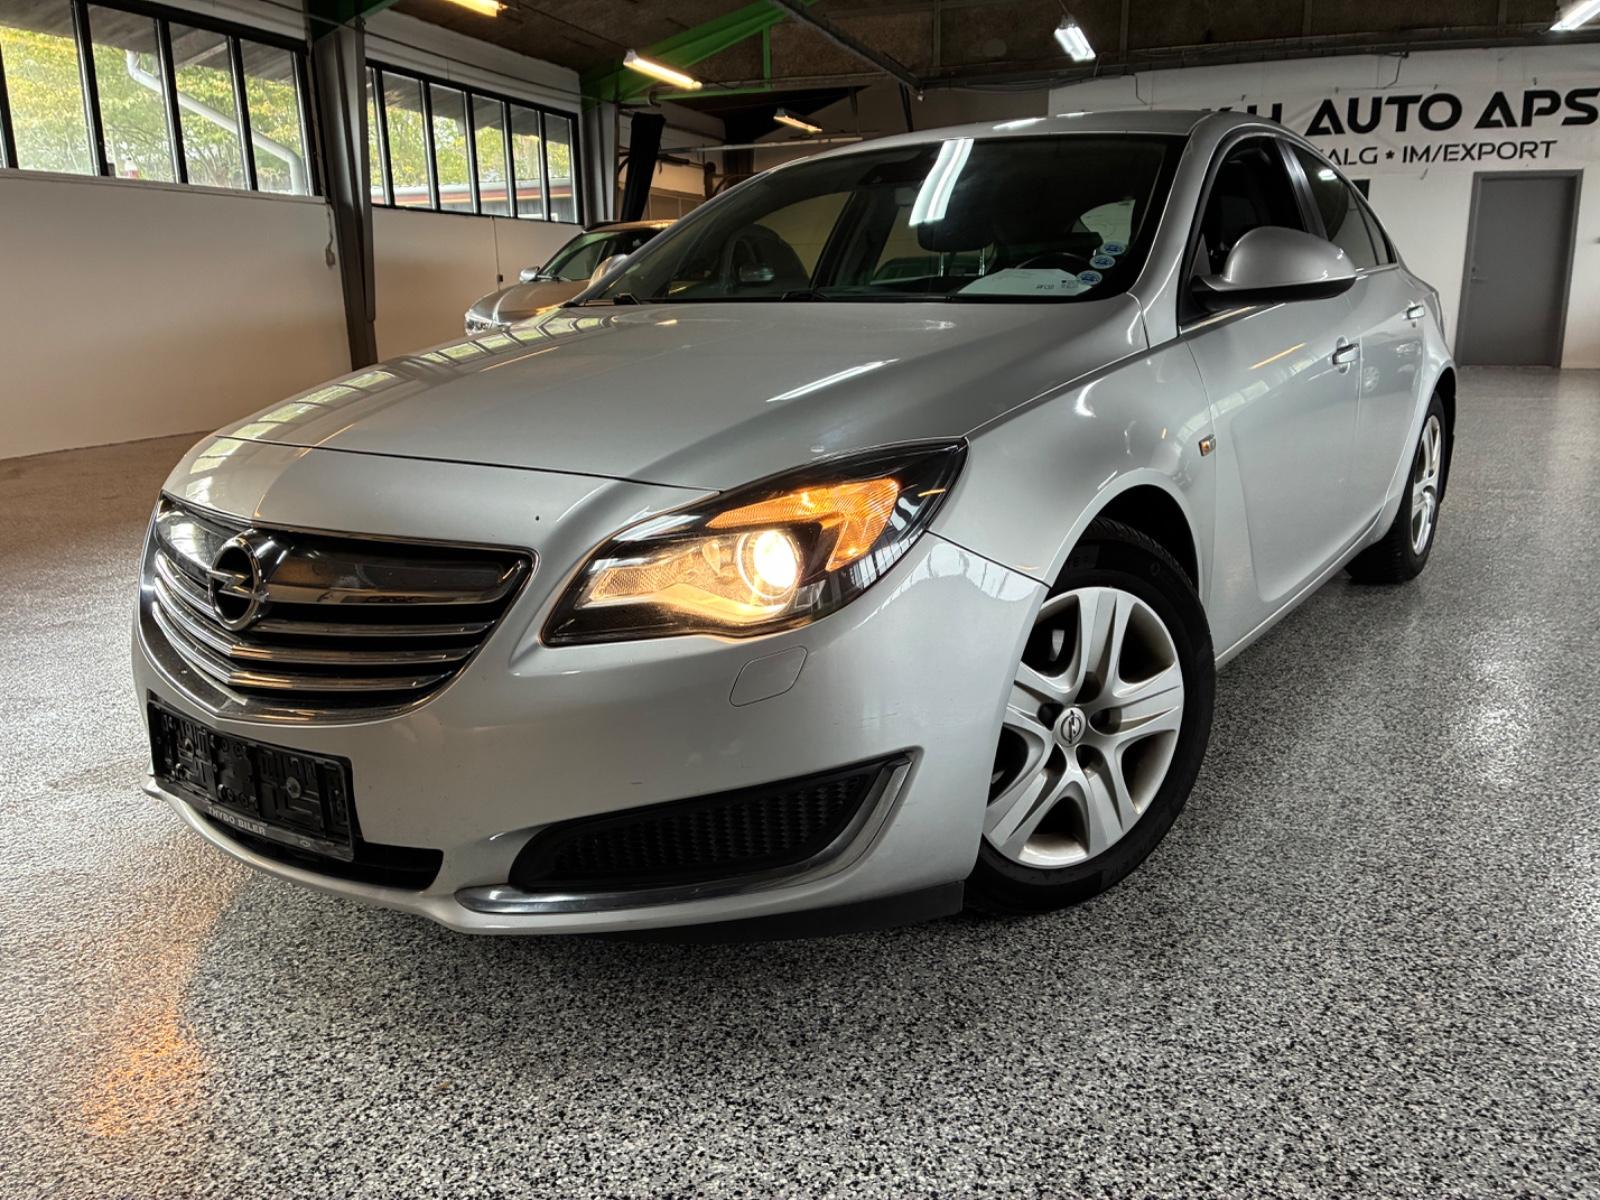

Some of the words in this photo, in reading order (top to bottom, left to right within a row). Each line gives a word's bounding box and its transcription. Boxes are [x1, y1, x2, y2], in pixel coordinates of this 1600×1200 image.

[1305, 93, 1463, 136] AUTO
[1474, 88, 1600, 129] APS
[1320, 146, 1378, 166] ALG
[1402, 140, 1557, 164] IM/EXPORT
